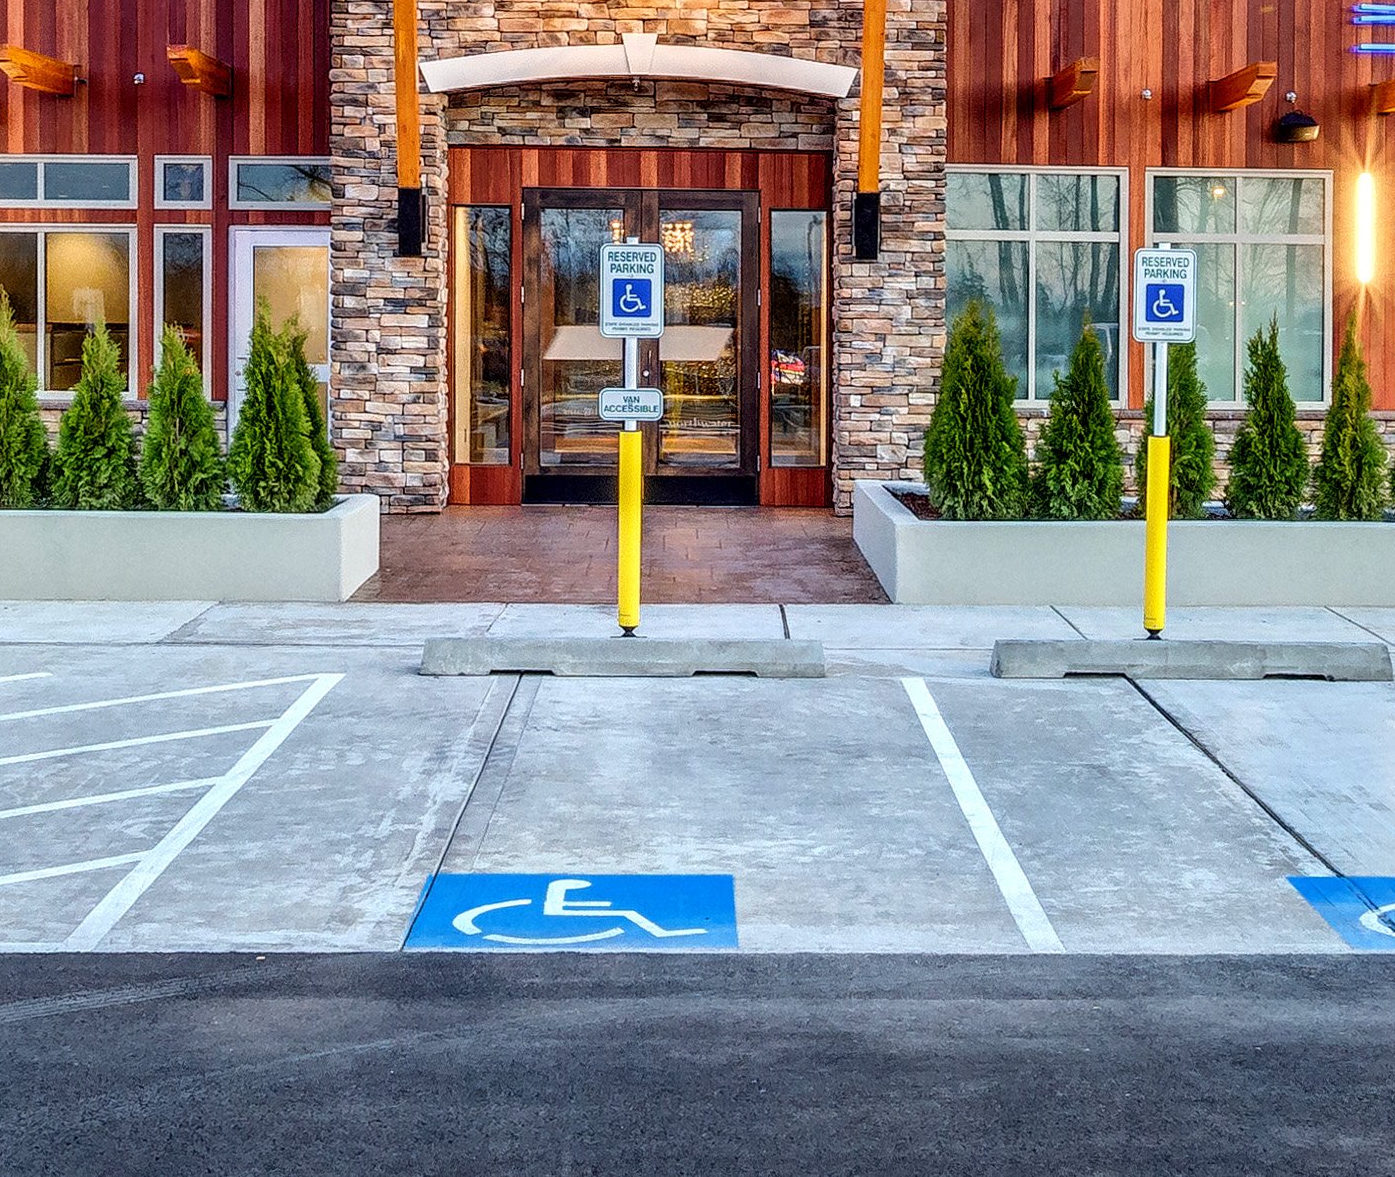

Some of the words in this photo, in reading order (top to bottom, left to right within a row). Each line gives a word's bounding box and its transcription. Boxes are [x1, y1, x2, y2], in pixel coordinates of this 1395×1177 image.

[607, 251, 657, 262] RESERVED
[1141, 256, 1190, 268] RESERVED
[610, 263, 655, 274] PARKING
[1144, 268, 1187, 279] PARKING
[623, 395, 640, 403] VAN
[603, 404, 659, 413] ACCESSIBLE
